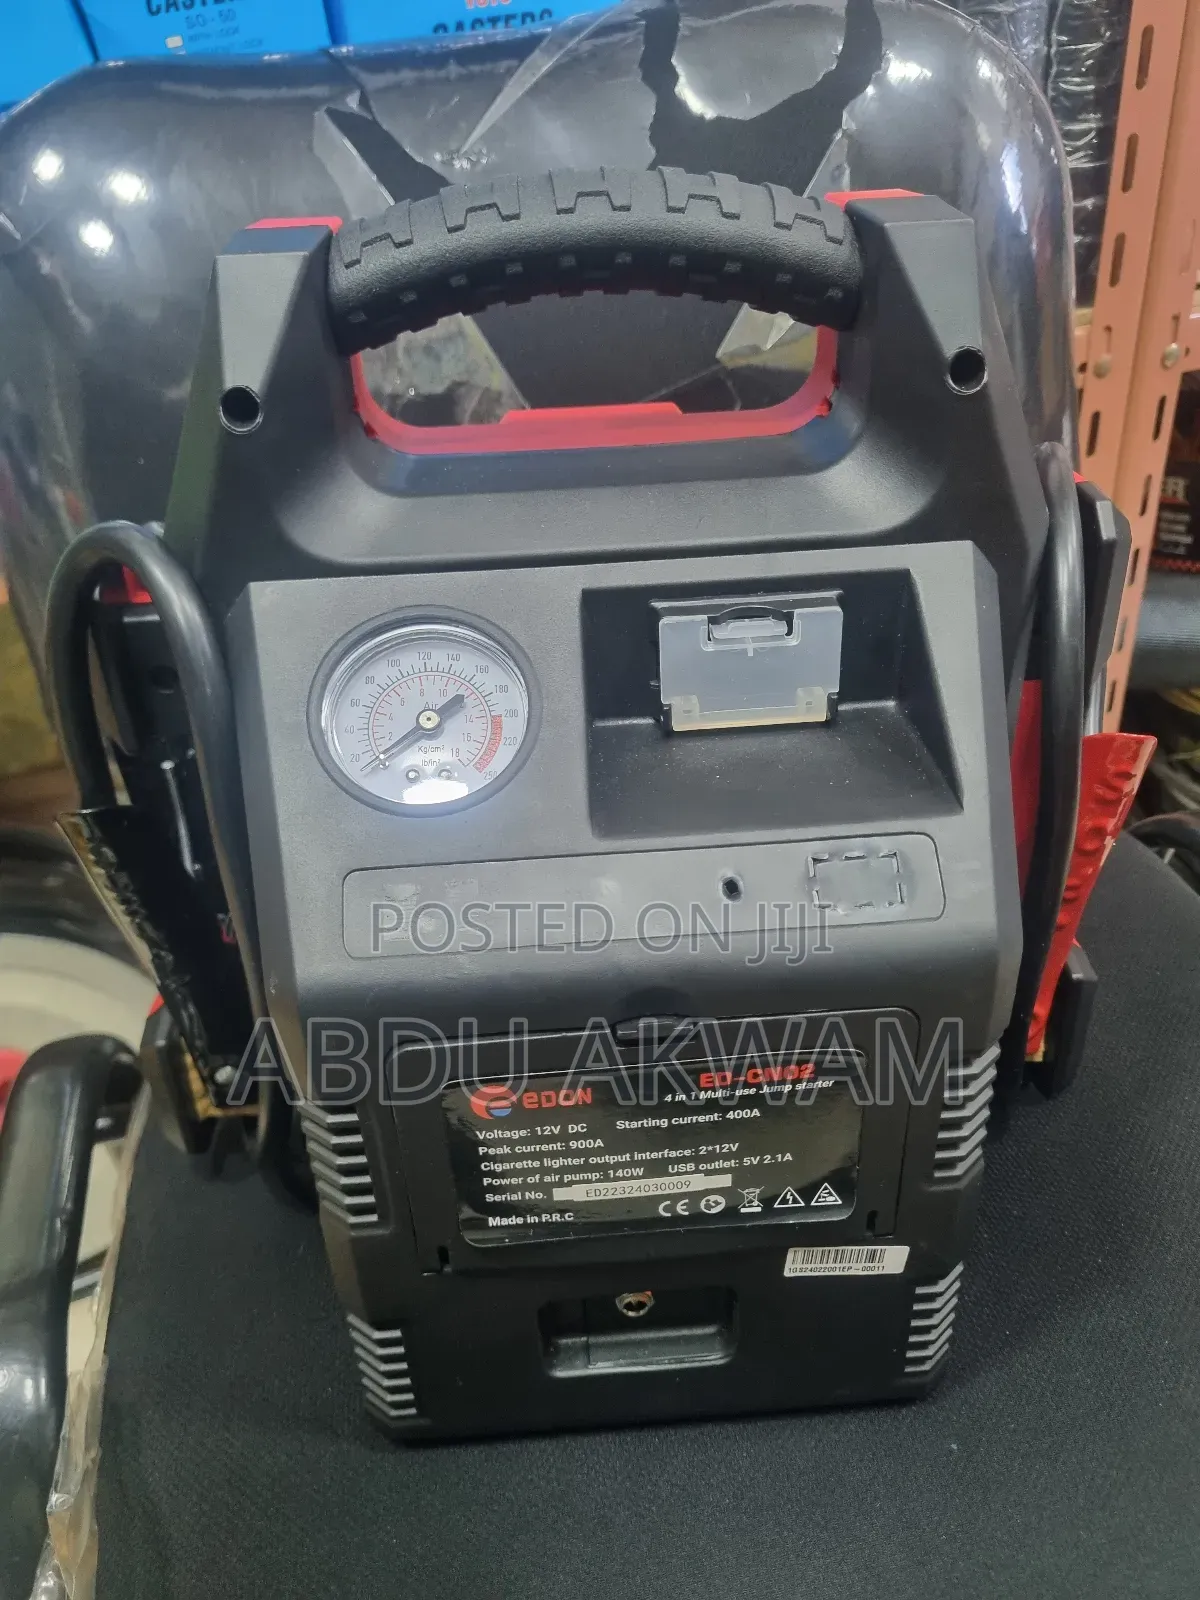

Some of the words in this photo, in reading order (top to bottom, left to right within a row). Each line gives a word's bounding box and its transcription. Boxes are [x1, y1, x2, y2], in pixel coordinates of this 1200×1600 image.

[417, 651, 432, 662] 120
[446, 653, 461, 663] 140
[387, 659, 401, 669] 100
[475, 665, 489, 675] 160
[365, 676, 375, 686] 80
[419, 688, 425, 698] 8
[438, 688, 448, 698] 10
[494, 685, 509, 695] 180
[350, 698, 361, 708] 60
[464, 714, 474, 724] 14
[504, 709, 519, 719] 200
[388, 732, 393, 741] 2
[462, 733, 472, 743] 16
[503, 737, 518, 747] 220
[350, 753, 360, 763] 20
[451, 748, 460, 758] 18
[484, 771, 498, 781] 250
[664, 1094, 672, 1102] 4
[675, 1092, 686, 1102] in
[700, 1087, 757, 1100] Multi-use
[759, 1083, 792, 1096] Jump
[795, 1079, 834, 1091] starter
[616, 1116, 669, 1129] Starting
[672, 1112, 722, 1125] current:
[726, 1108, 761, 1120] 400A
[476, 1127, 531, 1140] Voltage:
[535, 1124, 560, 1136] 12V
[569, 1123, 587, 1134] DC
[479, 1143, 511, 1156] Peak
[515, 1141, 565, 1153] current:
[570, 1138, 604, 1150] 900A
[481, 1158, 541, 1172] Cigarette
[544, 1153, 586, 1169] lighter
[589, 1152, 631, 1165] output
[634, 1148, 695, 1161] interface:
[668, 1164, 696, 1174] USB
[699, 1159, 739, 1171] outlet:
[743, 1156, 760, 1166] 5V
[763, 1153, 793, 1164] 2.1A
[483, 1175, 523, 1187] Power
[527, 1174, 541, 1183] of
[544, 1173, 560, 1183] air
[564, 1171, 604, 1184] pump:
[608, 1167, 645, 1178] 140W
[586, 1180, 691, 1198] ED22324030009
[485, 1190, 521, 1203] Serial
[525, 1189, 547, 1200] No.
[488, 1215, 524, 1227] Made
[527, 1213, 539, 1224] in
